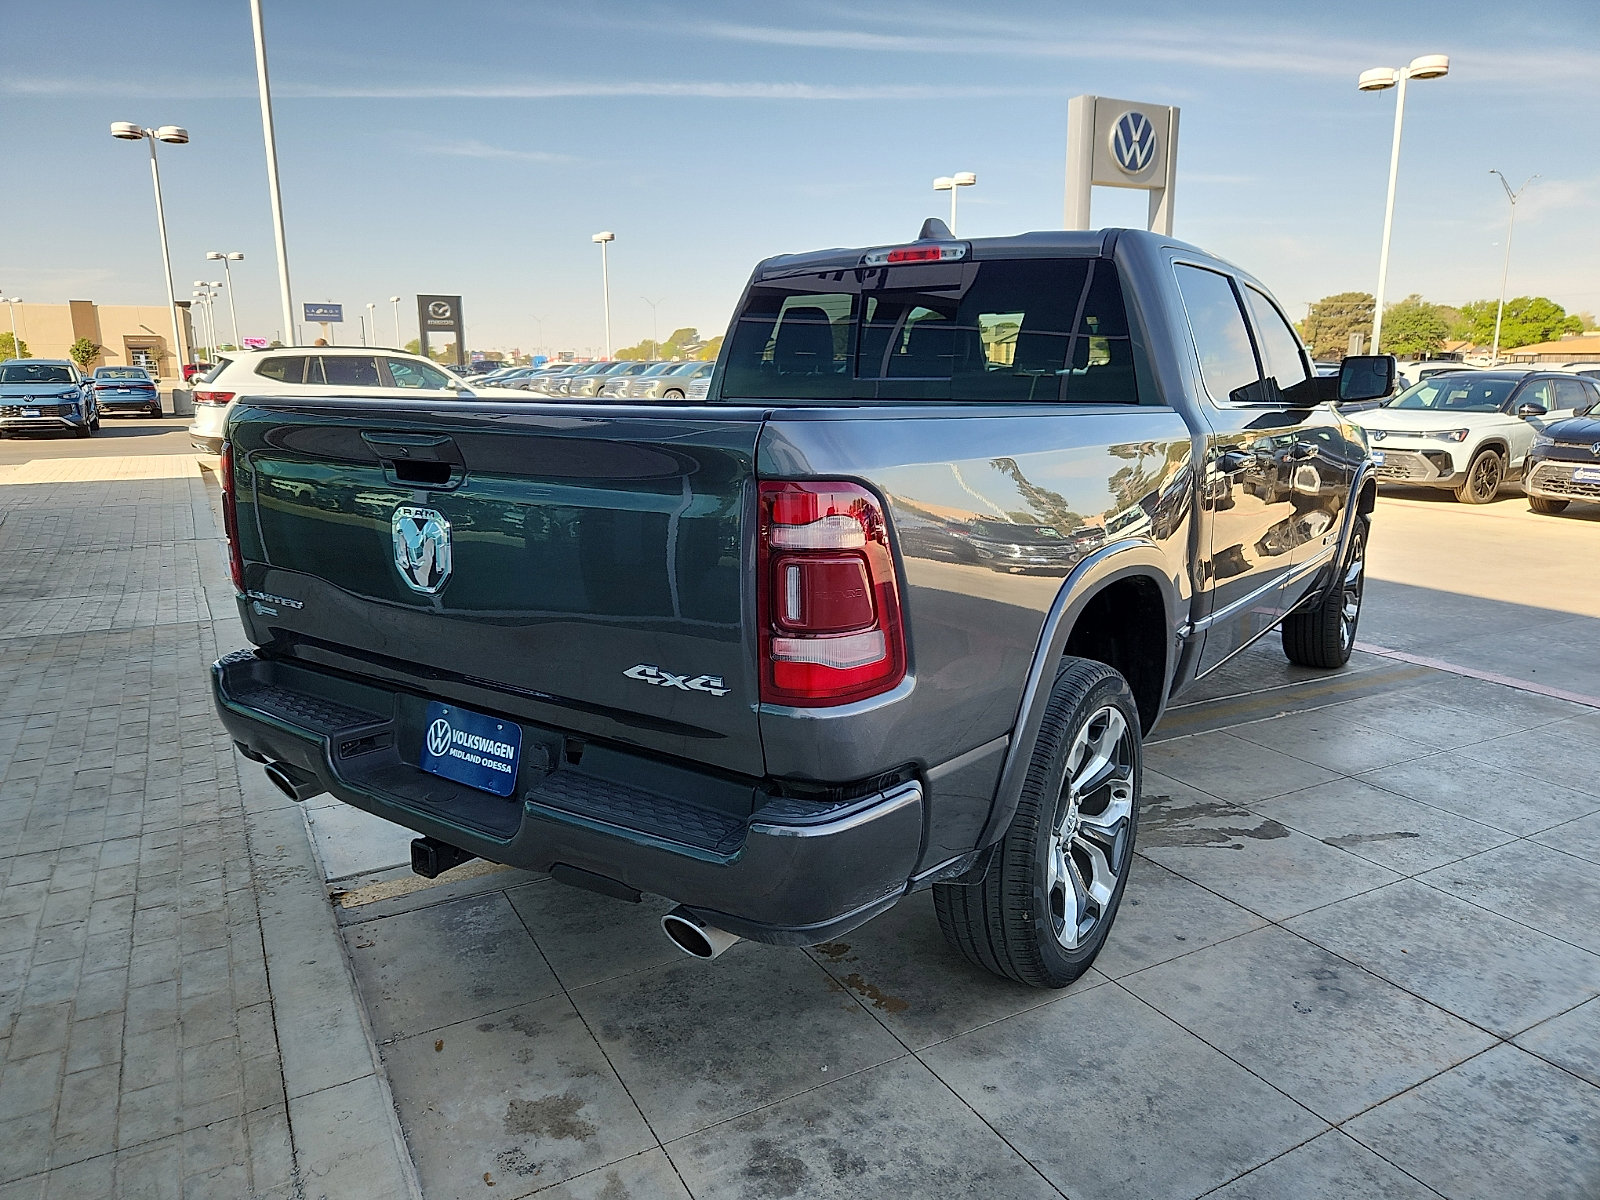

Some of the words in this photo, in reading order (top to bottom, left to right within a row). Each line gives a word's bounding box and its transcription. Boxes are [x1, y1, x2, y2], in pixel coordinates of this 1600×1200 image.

[1111, 111, 1156, 174] VW
[403, 508, 435, 518] RAM
[452, 729, 515, 760] VOLKSWAGEN
[449, 747, 482, 764] MIDLAND
[481, 757, 513, 774] ODESSA
